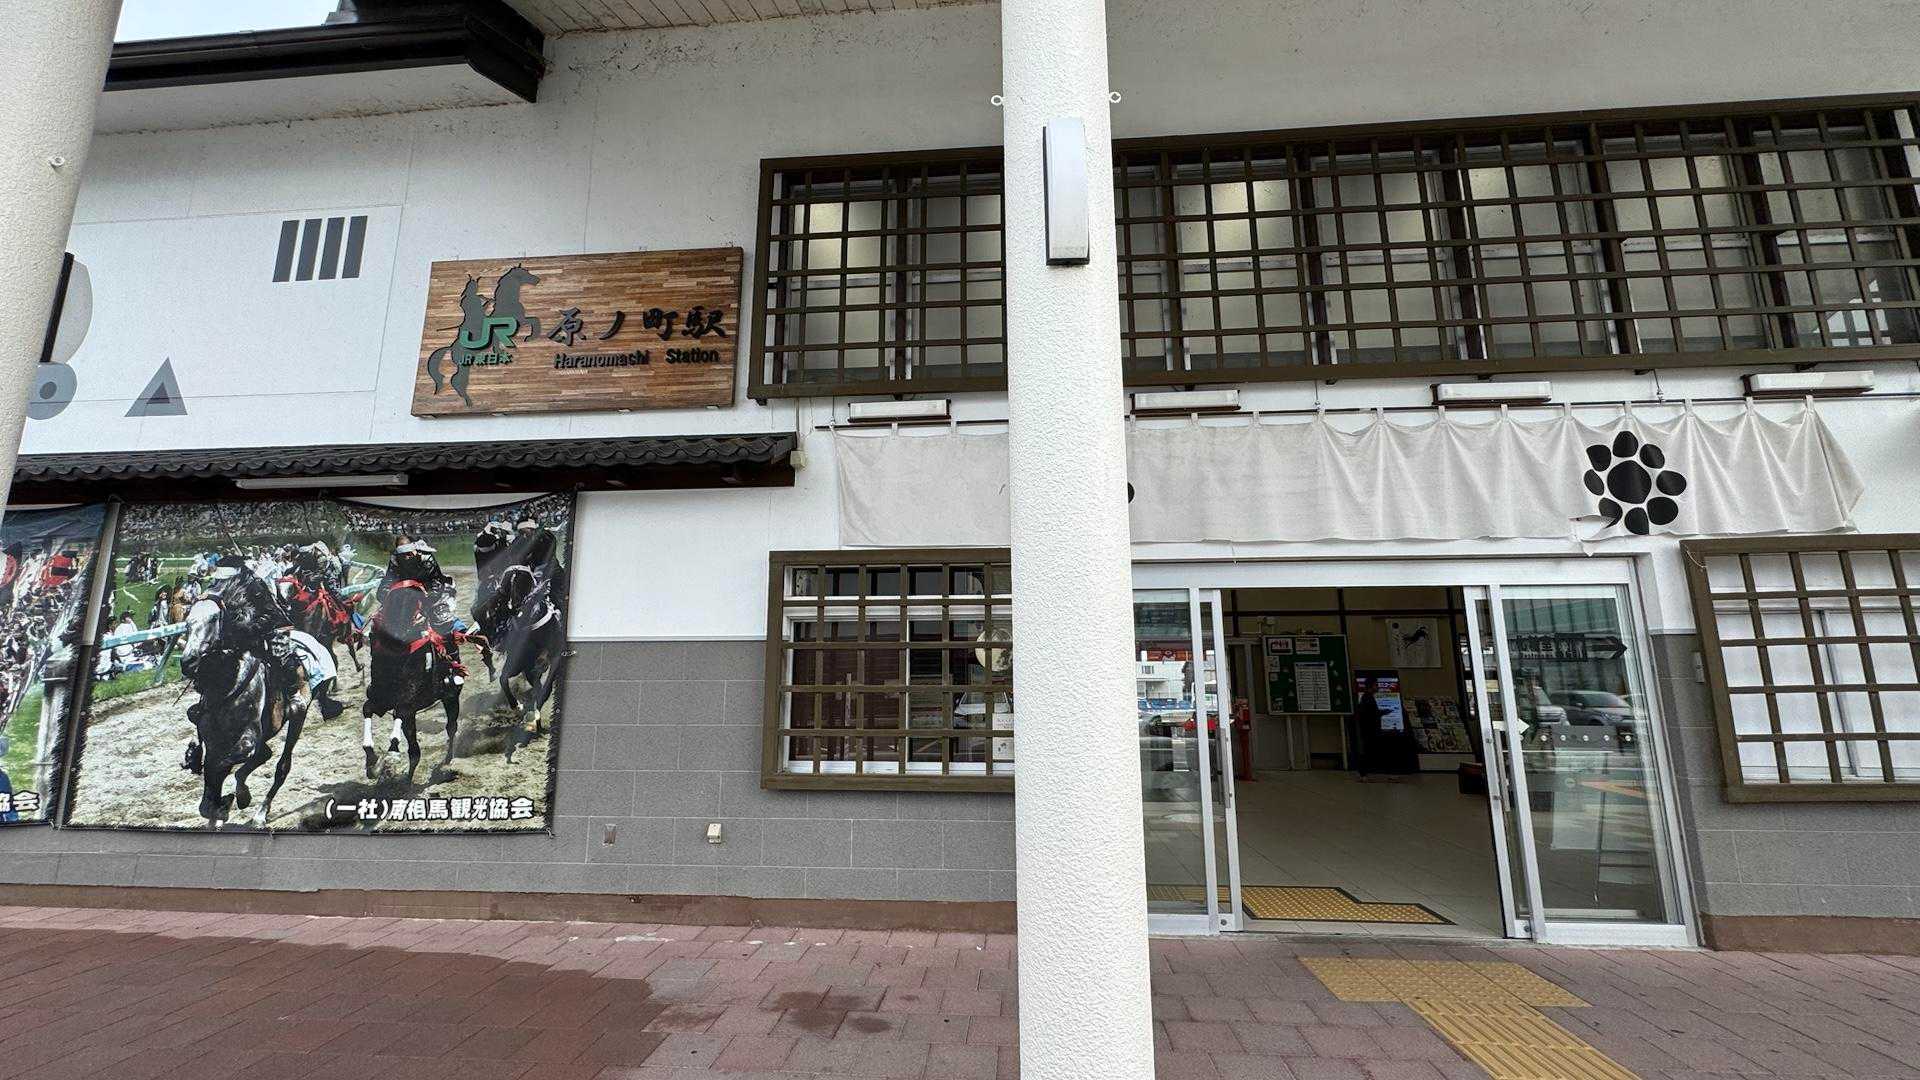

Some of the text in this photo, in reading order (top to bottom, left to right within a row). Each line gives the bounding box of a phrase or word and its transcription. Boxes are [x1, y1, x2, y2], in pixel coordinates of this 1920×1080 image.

[459, 317, 518, 350] JR
[548, 305, 727, 347] 原ノ町駅
[459, 351, 513, 366] JR東日本
[554, 348, 720, 369] Haranomachi Station
